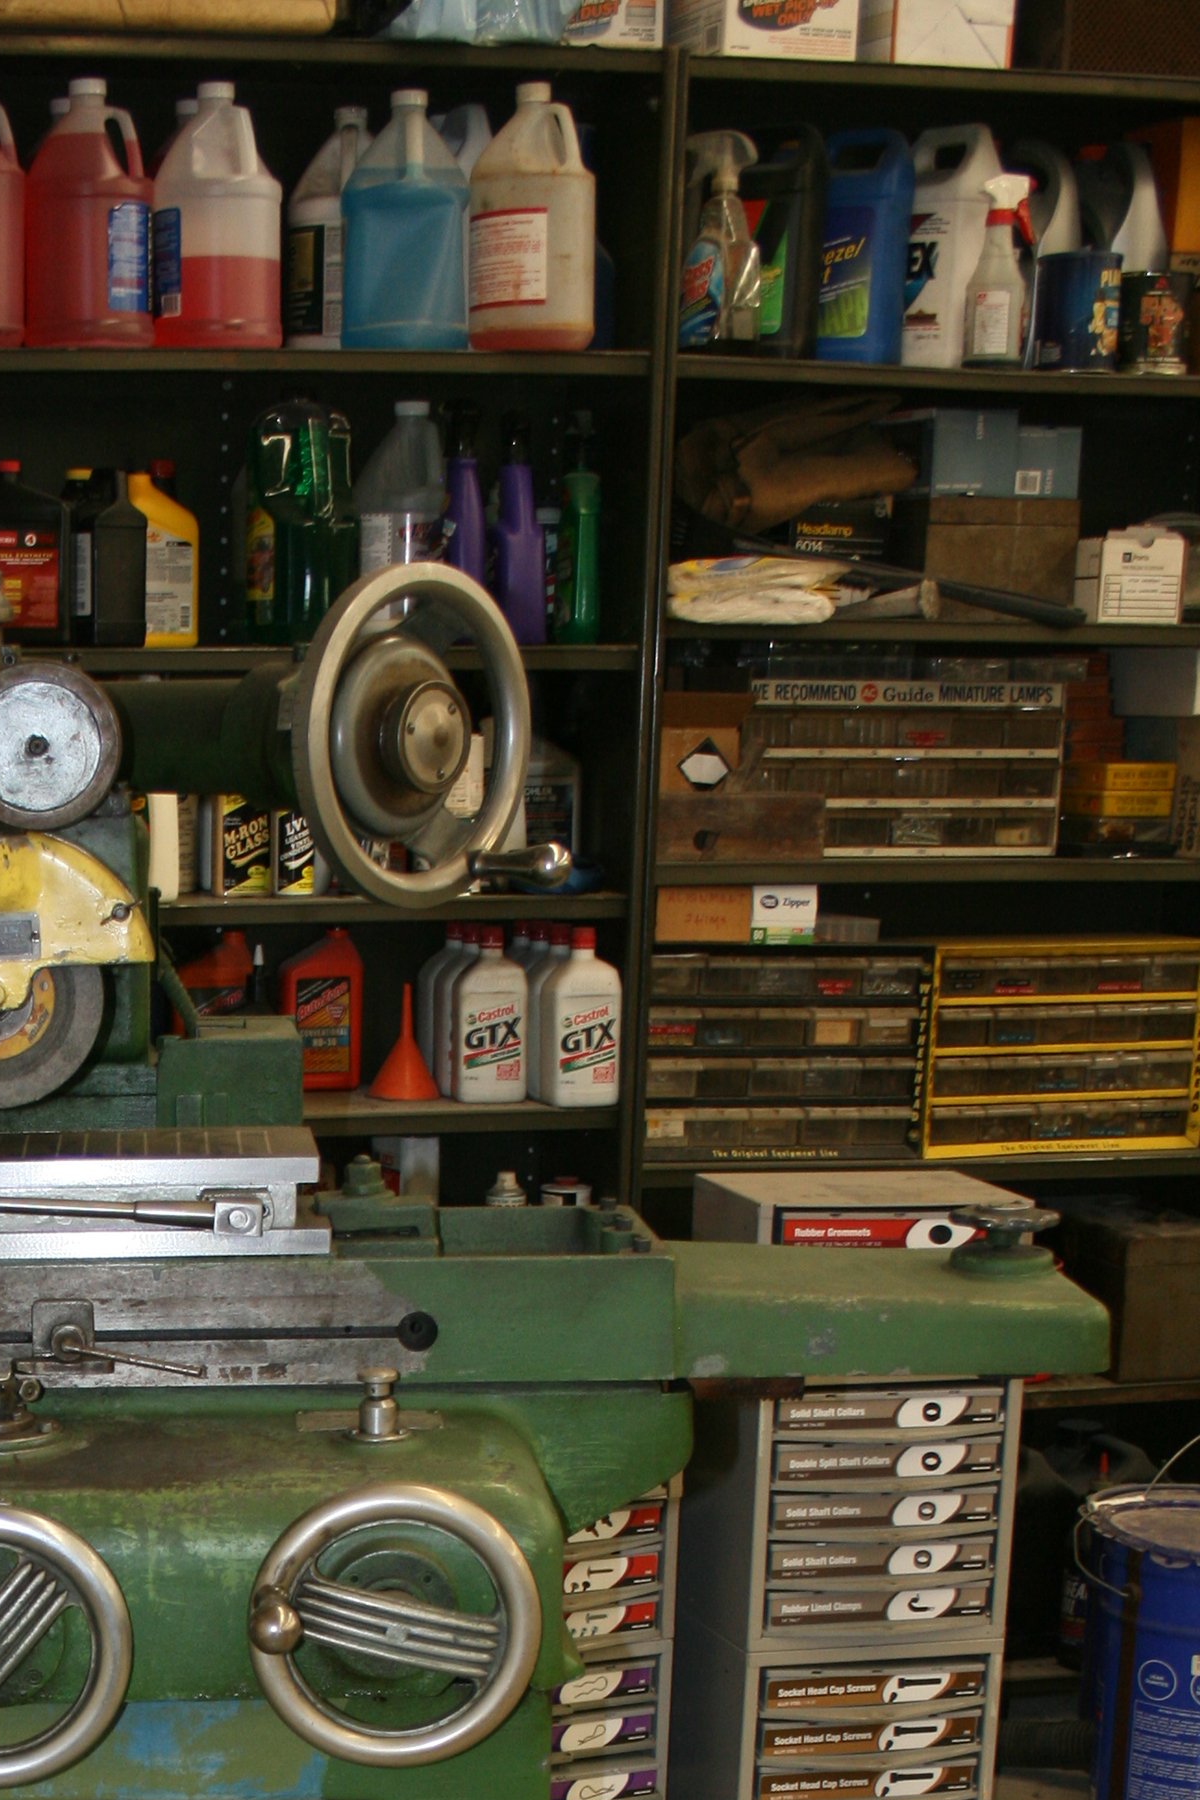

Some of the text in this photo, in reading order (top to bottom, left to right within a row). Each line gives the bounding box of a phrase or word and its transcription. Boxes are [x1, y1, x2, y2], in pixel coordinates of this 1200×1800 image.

[796, 522, 853, 537] Headlamp
[774, 683, 857, 702] RECOMMEND
[882, 686, 934, 703] Guide
[939, 684, 1004, 704] MINIATURE
[1009, 685, 1054, 704] LAMPS
[225, 828, 270, 860] GLASS
[782, 897, 811, 908] Zipper
[477, 1004, 515, 1023] Castrol
[573, 1006, 609, 1026] Castrol
[464, 1017, 521, 1050] GTX
[561, 1019, 616, 1053] GTX
[794, 1227, 872, 1238] Rubber Grommets
[790, 1406, 865, 1419] Solid Shaft Collars
[789, 1455, 890, 1469] Double Split Shaft Collars
[786, 1505, 861, 1518] Solid Shaft Collars
[782, 1555, 857, 1568] Solid Shaft Collars
[781, 1601, 863, 1615] Rubber Lined Clamps
[777, 1683, 877, 1698] Socket Head Cap Screws
[774, 1732, 873, 1746] Socket Head Cap Screws
[770, 1778, 869, 1793] Socket Head Cap Screws
